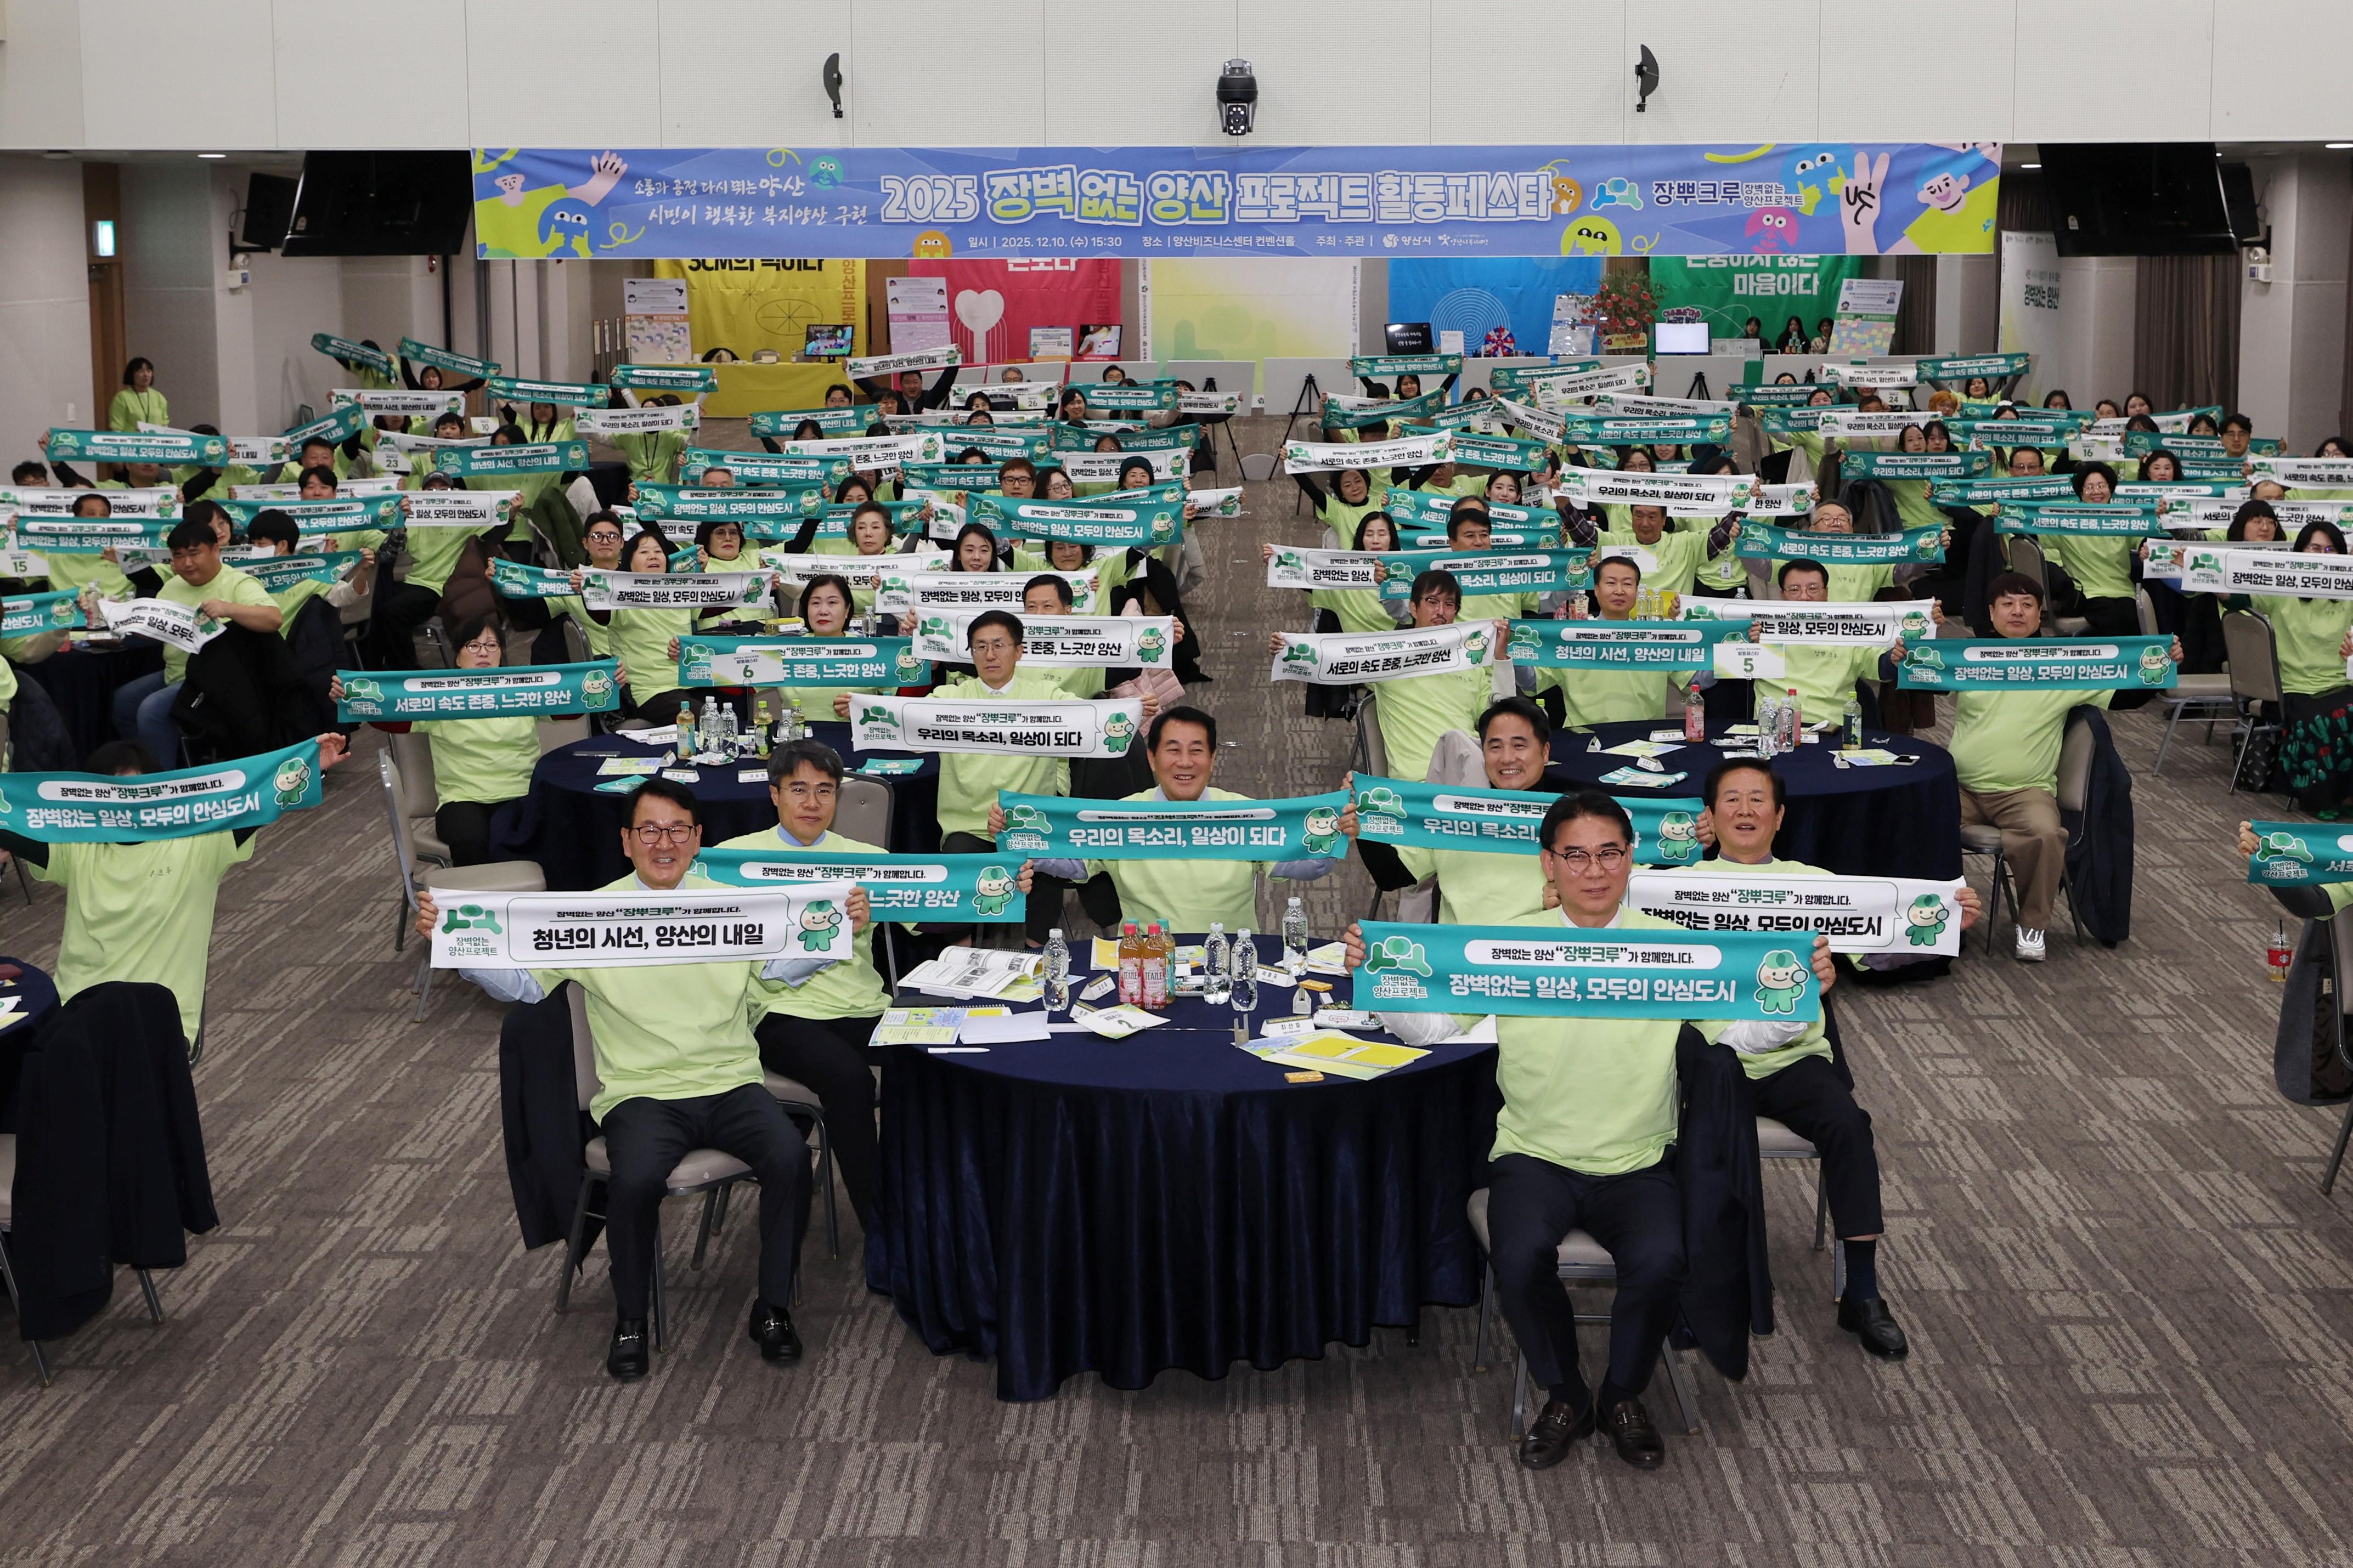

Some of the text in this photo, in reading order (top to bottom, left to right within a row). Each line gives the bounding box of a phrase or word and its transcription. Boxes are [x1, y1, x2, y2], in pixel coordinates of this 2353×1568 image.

[635, 179, 667, 196] 소통과
[673, 179, 697, 196] 공정
[702, 179, 728, 194] 다시
[759, 174, 805, 197] 양산
[1652, 180, 1743, 206] 장뿌크루
[1744, 183, 1784, 195] 장벽없는
[881, 174, 979, 223] 2025
[1149, 172, 1232, 224] 양산
[1236, 173, 1373, 223] 프로젝트
[1375, 171, 1555, 223] 활동페스타
[1743, 195, 1805, 207] 양산프로젝트
[648, 205, 868, 226] 시민이 행복한 복지양산 구현
[968, 237, 988, 247] 일시
[1092, 237, 1122, 248] 15:30
[1142, 237, 1163, 247] 장소
[1173, 236, 1252, 247] 양산비즈니스센터
[1255, 236, 1295, 246] 컨벤션홀
[1402, 236, 1431, 246] 양산시
[1734, 273, 1819, 295] 마음이다
[2083, 448, 2094, 457] 16
[386, 459, 399, 468] 23
[1598, 486, 1715, 502] 우리의 목소리, 일상이 되다
[673, 502, 793, 515] 장벽없는 일상, 모두의 안심도시
[1011, 520, 1143, 539] 장벽없는 일상, 모두의 안심도시
[1778, 543, 1909, 558] 서로의 속도 존중, 느긋한 양산
[13, 561, 27, 572] 15
[2232, 572, 2332, 590] 장벽없는 일상, 모두의
[1778, 622, 1885, 636] 일상, 모두의 안심도시
[1031, 641, 1122, 656] 존중, 느긋한 양산
[1555, 645, 1705, 663] 청년의 시선, 양산의 내일
[1327, 649, 1451, 675] 서로의 속도 존중, 느긋한 양산
[1743, 658, 1754, 672] 5
[743, 665, 754, 678] 6
[794, 663, 887, 680] 존중, 느긋한 양산
[1955, 664, 2128, 682] 장벽없는 일상, 모두의 안심도시
[394, 689, 571, 712] 서로의 속도 존중, 느긋한 양산
[917, 728, 1082, 746] 우리의 목소리, 일상이 되다
[26, 792, 260, 829] 장벽없는 일상, 모두의 안심도시
[1069, 827, 1286, 847] 우리의 목소리, 일상이 되다
[1424, 819, 1540, 844] 우리의 목소리,
[1006, 841, 1049, 850] 양산프로젝트
[762, 867, 795, 877] 장벽없는
[797, 868, 814, 878] 양산
[883, 870, 926, 879] 함께합니다.
[2262, 869, 2308, 878] 양산프로젝트
[2270, 861, 2300, 871] 장벽없는
[924, 890, 961, 908] 양산
[1674, 890, 1709, 902] 장벽없는
[1712, 892, 1730, 902] 양산
[1804, 895, 1851, 905] 함께합니다.
[693, 906, 741, 914] 함께합니다.
[1813, 916, 1882, 938] 안심도시
[455, 937, 489, 947] 장벽없는
[533, 923, 763, 950] 청년의 시선, 양산의 내일
[448, 946, 498, 956] 양산프로젝트
[1491, 948, 1531, 960] 장벽없는
[1534, 949, 1554, 961] 양산
[1640, 951, 1694, 964] 함께합니다.
[1145, 972, 1163, 980] TEAZLE
[1380, 975, 1418, 987] 장벽없는
[1372, 986, 1428, 999] 양산프로젝트
[1449, 974, 1736, 1003] 장벽없는 일상, 모두의 안심도시
